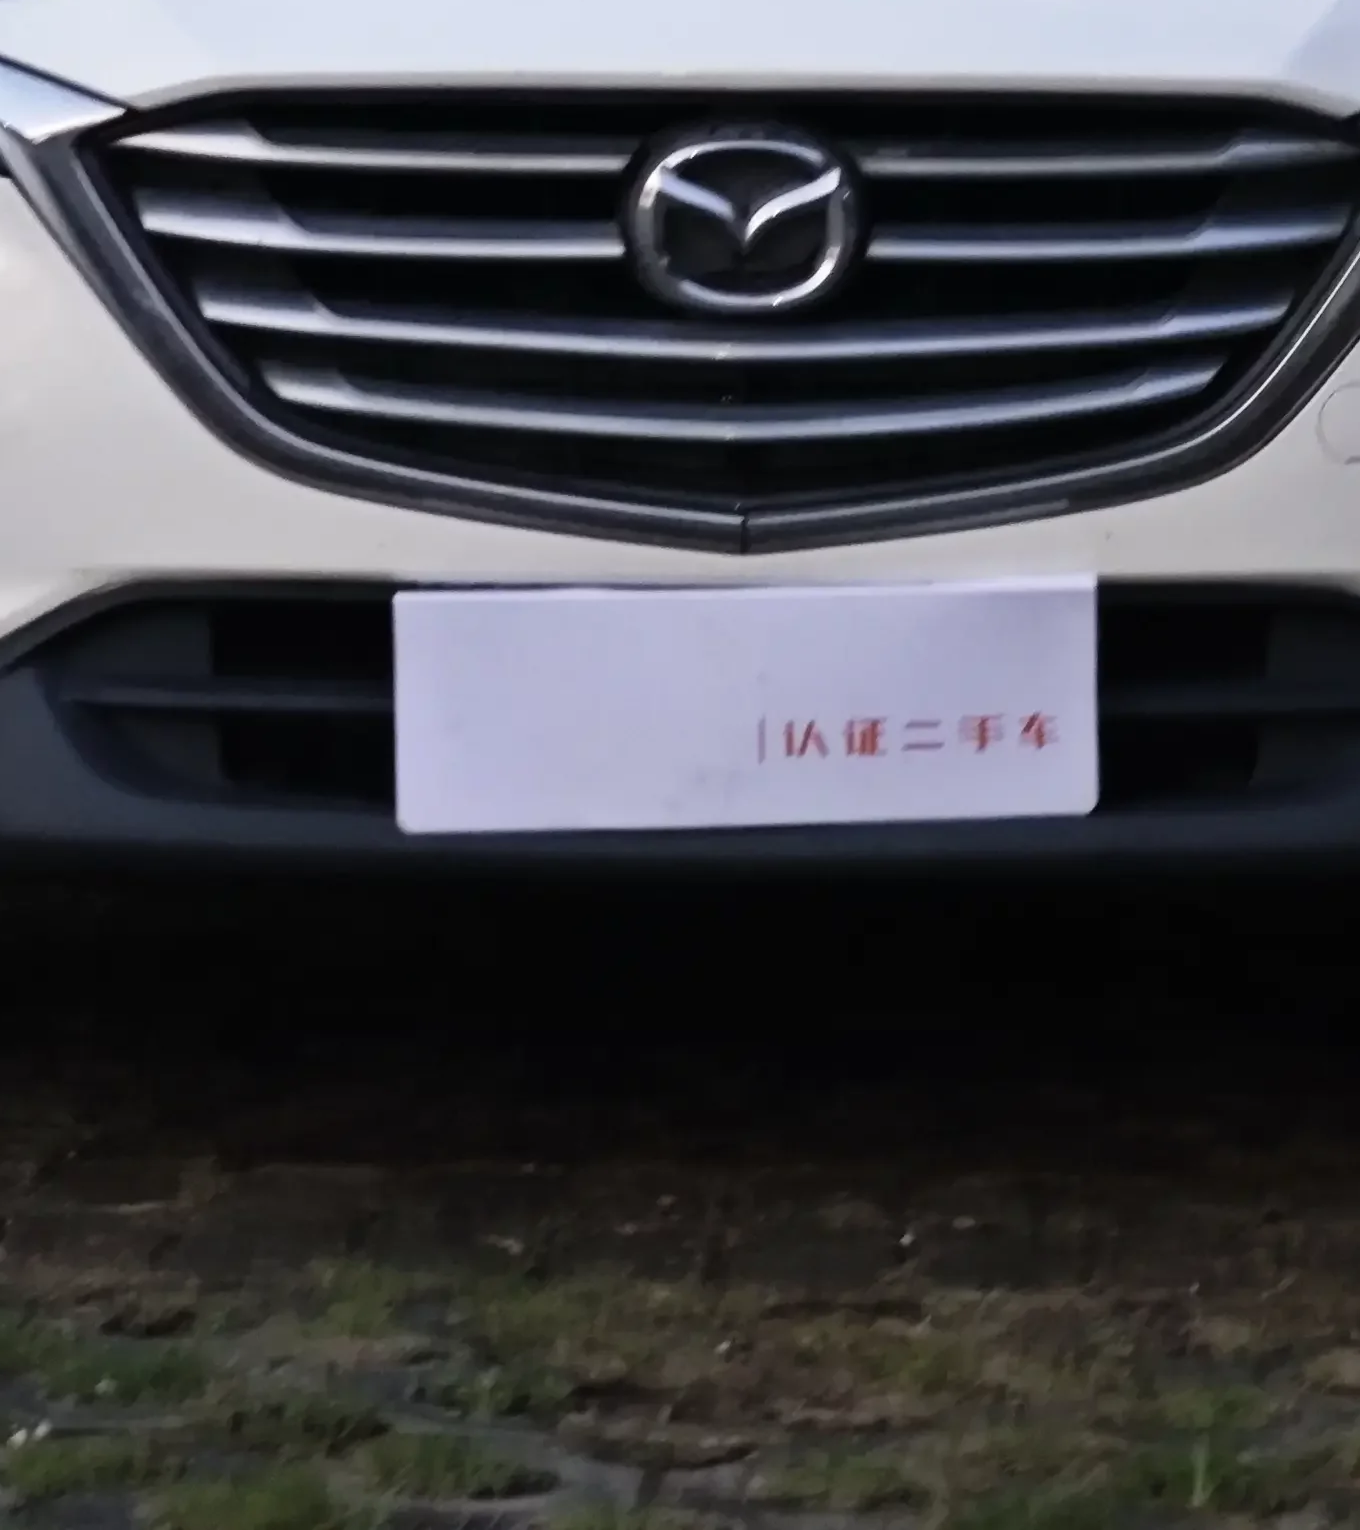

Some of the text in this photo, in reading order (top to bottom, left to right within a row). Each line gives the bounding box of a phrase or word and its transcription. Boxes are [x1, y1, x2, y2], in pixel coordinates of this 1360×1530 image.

[782, 710, 1060, 760] 认证二手车
